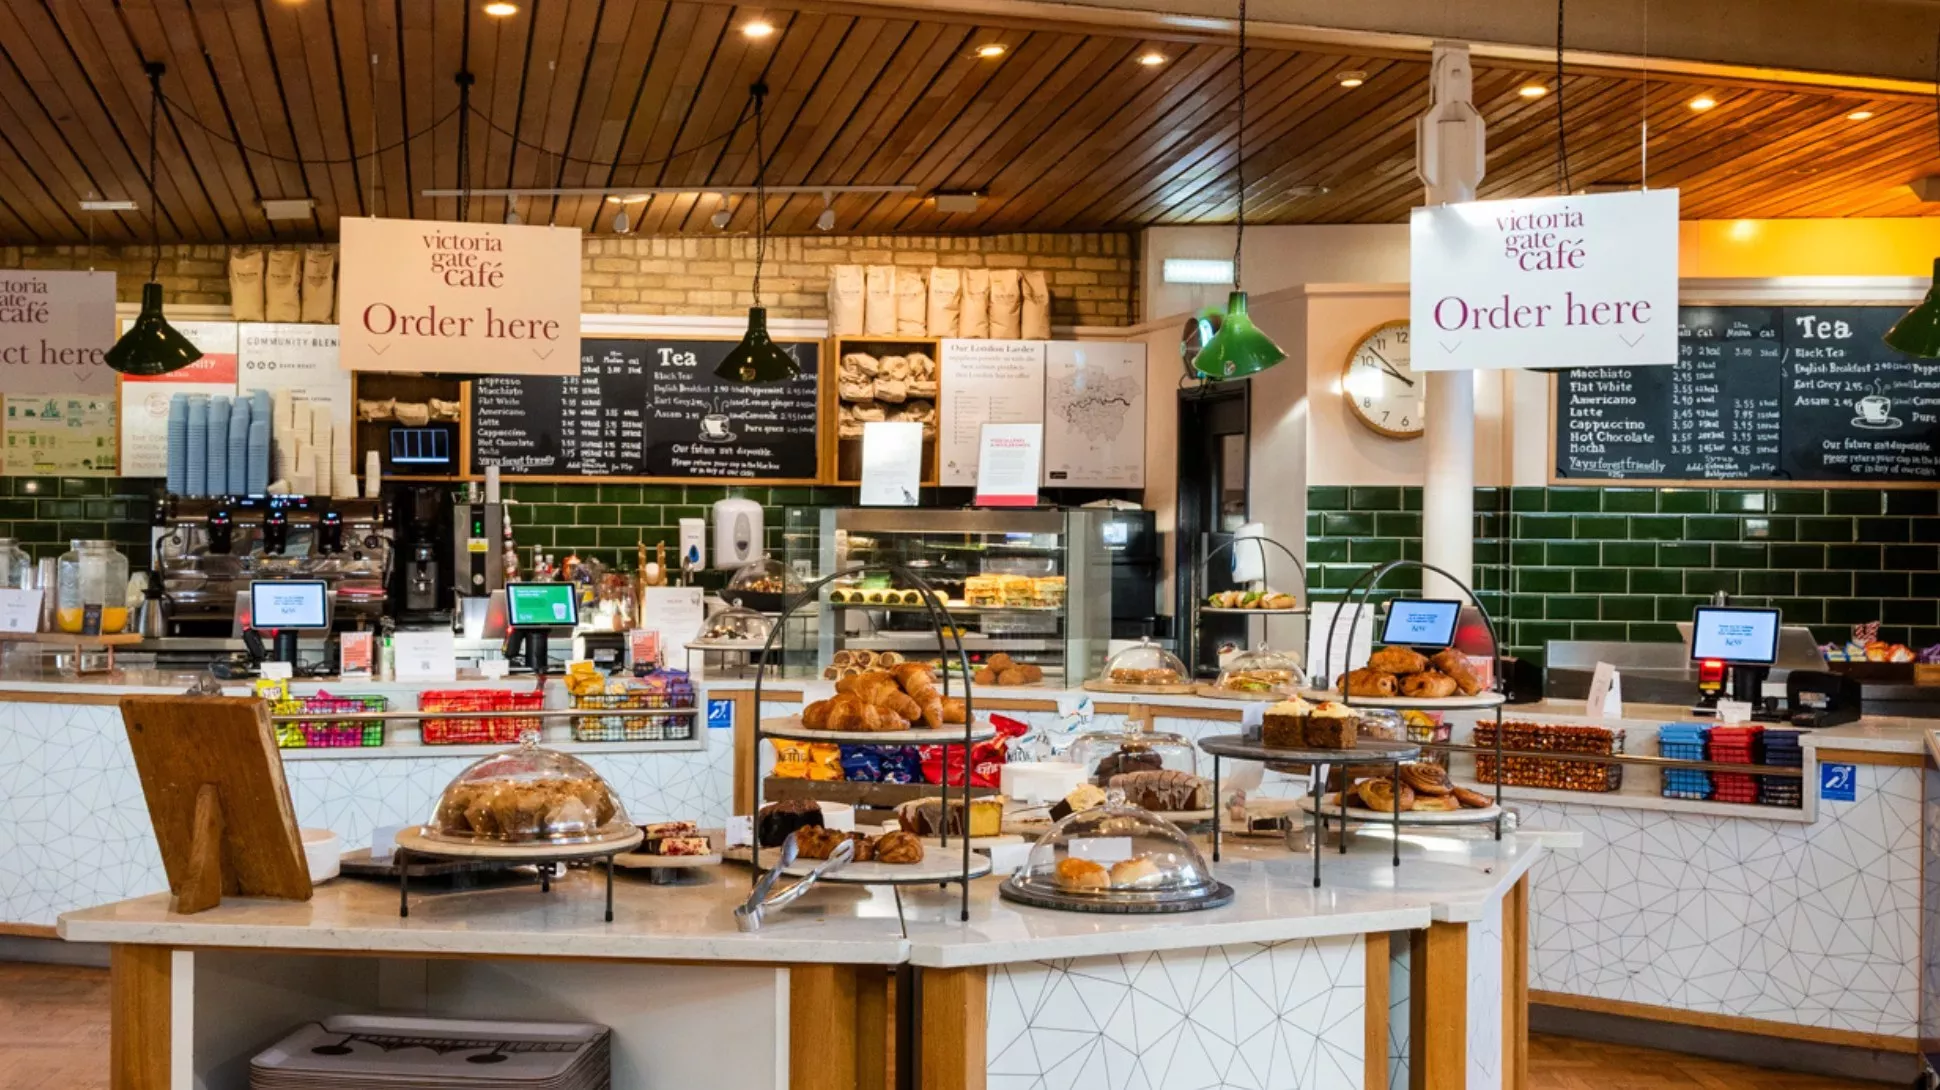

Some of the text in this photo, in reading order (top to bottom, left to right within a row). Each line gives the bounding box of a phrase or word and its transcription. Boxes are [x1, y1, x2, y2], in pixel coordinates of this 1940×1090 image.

[1497, 206, 1584, 231] victoria
[422, 230, 502, 252] victoria
[1506, 232, 1556, 258] gate
[1519, 239, 1585, 271] café
[431, 252, 477, 273] gate
[444, 262, 504, 288] café
[1434, 292, 1652, 331] Order here
[363, 303, 559, 340] Order here
[1796, 314, 1853, 339] Tea
[1396, 332, 1408, 343] 12
[1678, 329, 1691, 337] all
[1697, 328, 1713, 338] Cal
[1760, 329, 1775, 338] Cal
[247, 337, 340, 347] COMMUNITY BLEN
[1376, 339, 1386, 350] 11
[40, 339, 104, 366] here
[1678, 345, 1692, 356] .70
[1795, 347, 1844, 358] Black Tea
[657, 348, 697, 366] Tea
[1361, 356, 1374, 366] 10
[1794, 362, 1828, 375] English
[1829, 362, 1871, 373] Breakfast
[654, 371, 677, 380] Black
[1570, 368, 1692, 382] Macchiato 2.95
[1570, 381, 1693, 394] Flat White 3.55
[1794, 379, 1814, 389] Earl
[1816, 379, 1842, 391] Grey
[654, 396, 671, 404] Earl
[1363, 398, 1371, 407] 8
[1569, 394, 1636, 405] Americano
[1733, 398, 1754, 408] 3.55
[1794, 396, 1830, 406] Assam
[478, 408, 526, 416] Americano
[655, 409, 682, 418] Assam
[1382, 411, 1390, 422] 7
[1569, 408, 1603, 417] Latte
[1673, 408, 1693, 419] 3.45
[1912, 412, 1937, 422] Pure
[1401, 416, 1409, 426] 6
[1569, 417, 1753, 431] Cappuccino 3.50 3.95
[1570, 432, 1593, 442] Hot
[1596, 432, 1655, 443] Chocolate
[1732, 432, 1752, 442] 3.95
[672, 444, 688, 453] Our
[691, 444, 715, 454] future
[1570, 442, 1606, 453] Mocha
[1672, 444, 1692, 454] 3.75
[1732, 445, 1751, 456] 4.35
[1822, 439, 1841, 450] Our
[1844, 438, 1872, 450] future
[1569, 456, 1596, 471] Yayu
[1598, 456, 1625, 470] forest
[1626, 456, 1666, 472] friendly
[1824, 454, 1848, 465] Please
